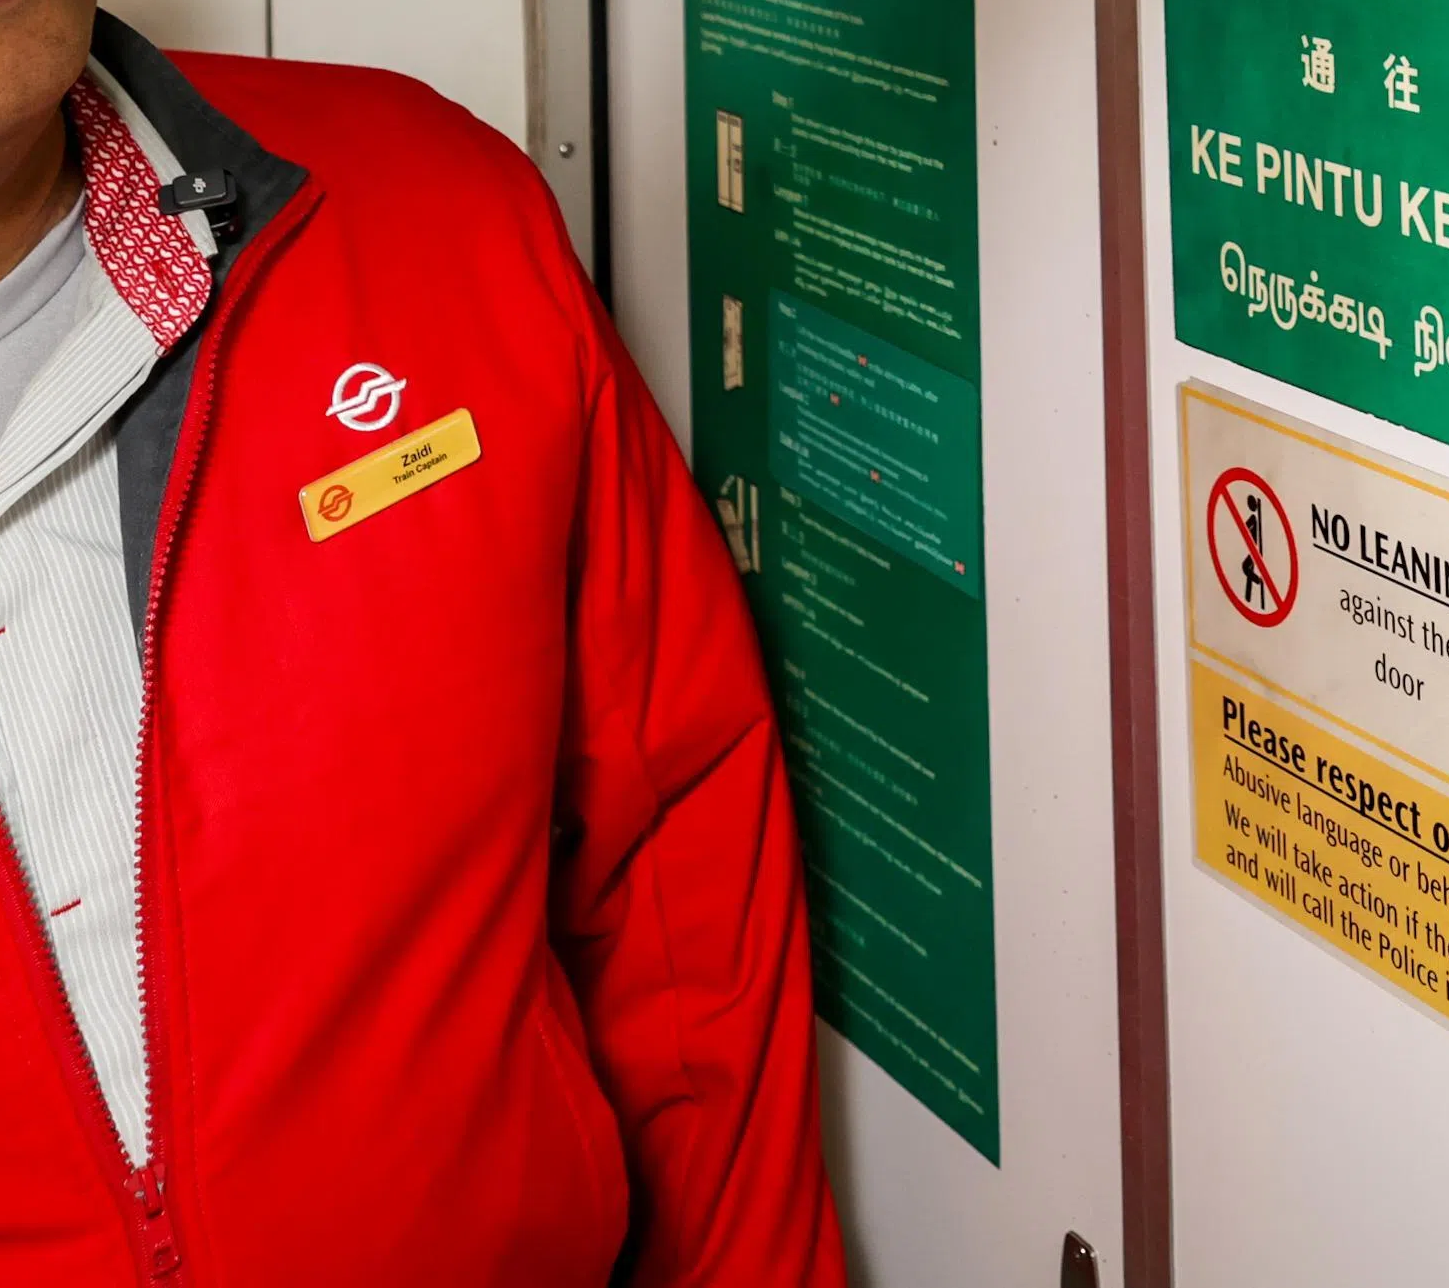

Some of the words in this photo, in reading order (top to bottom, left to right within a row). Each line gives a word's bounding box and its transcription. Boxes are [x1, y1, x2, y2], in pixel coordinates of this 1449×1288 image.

[1192, 125, 1243, 186] KE
[1257, 143, 1382, 227] PINTU
[1221, 242, 1392, 359] நெருக்கடி
[393, 469, 415, 485] Train
[416, 452, 448, 474] Captain
[401, 443, 432, 467] Zaidi
[1312, 504, 1349, 551] NO
[1340, 590, 1414, 643] against
[1375, 653, 1424, 700] door
[1222, 696, 1305, 772] Please
[1317, 754, 1421, 839] respect
[1223, 754, 1291, 814] Abusive
[1297, 792, 1382, 868] language
[1390, 856, 1409, 882] or
[1225, 799, 1250, 837] We
[1256, 823, 1287, 860] will
[1294, 843, 1332, 887] take
[1338, 874, 1398, 928] action
[1405, 900, 1419, 939] if
[1226, 844, 1258, 880] and
[1265, 866, 1296, 903] will
[1302, 891, 1333, 927] call
[1341, 910, 1372, 951] the
[1379, 932, 1438, 993] Police
